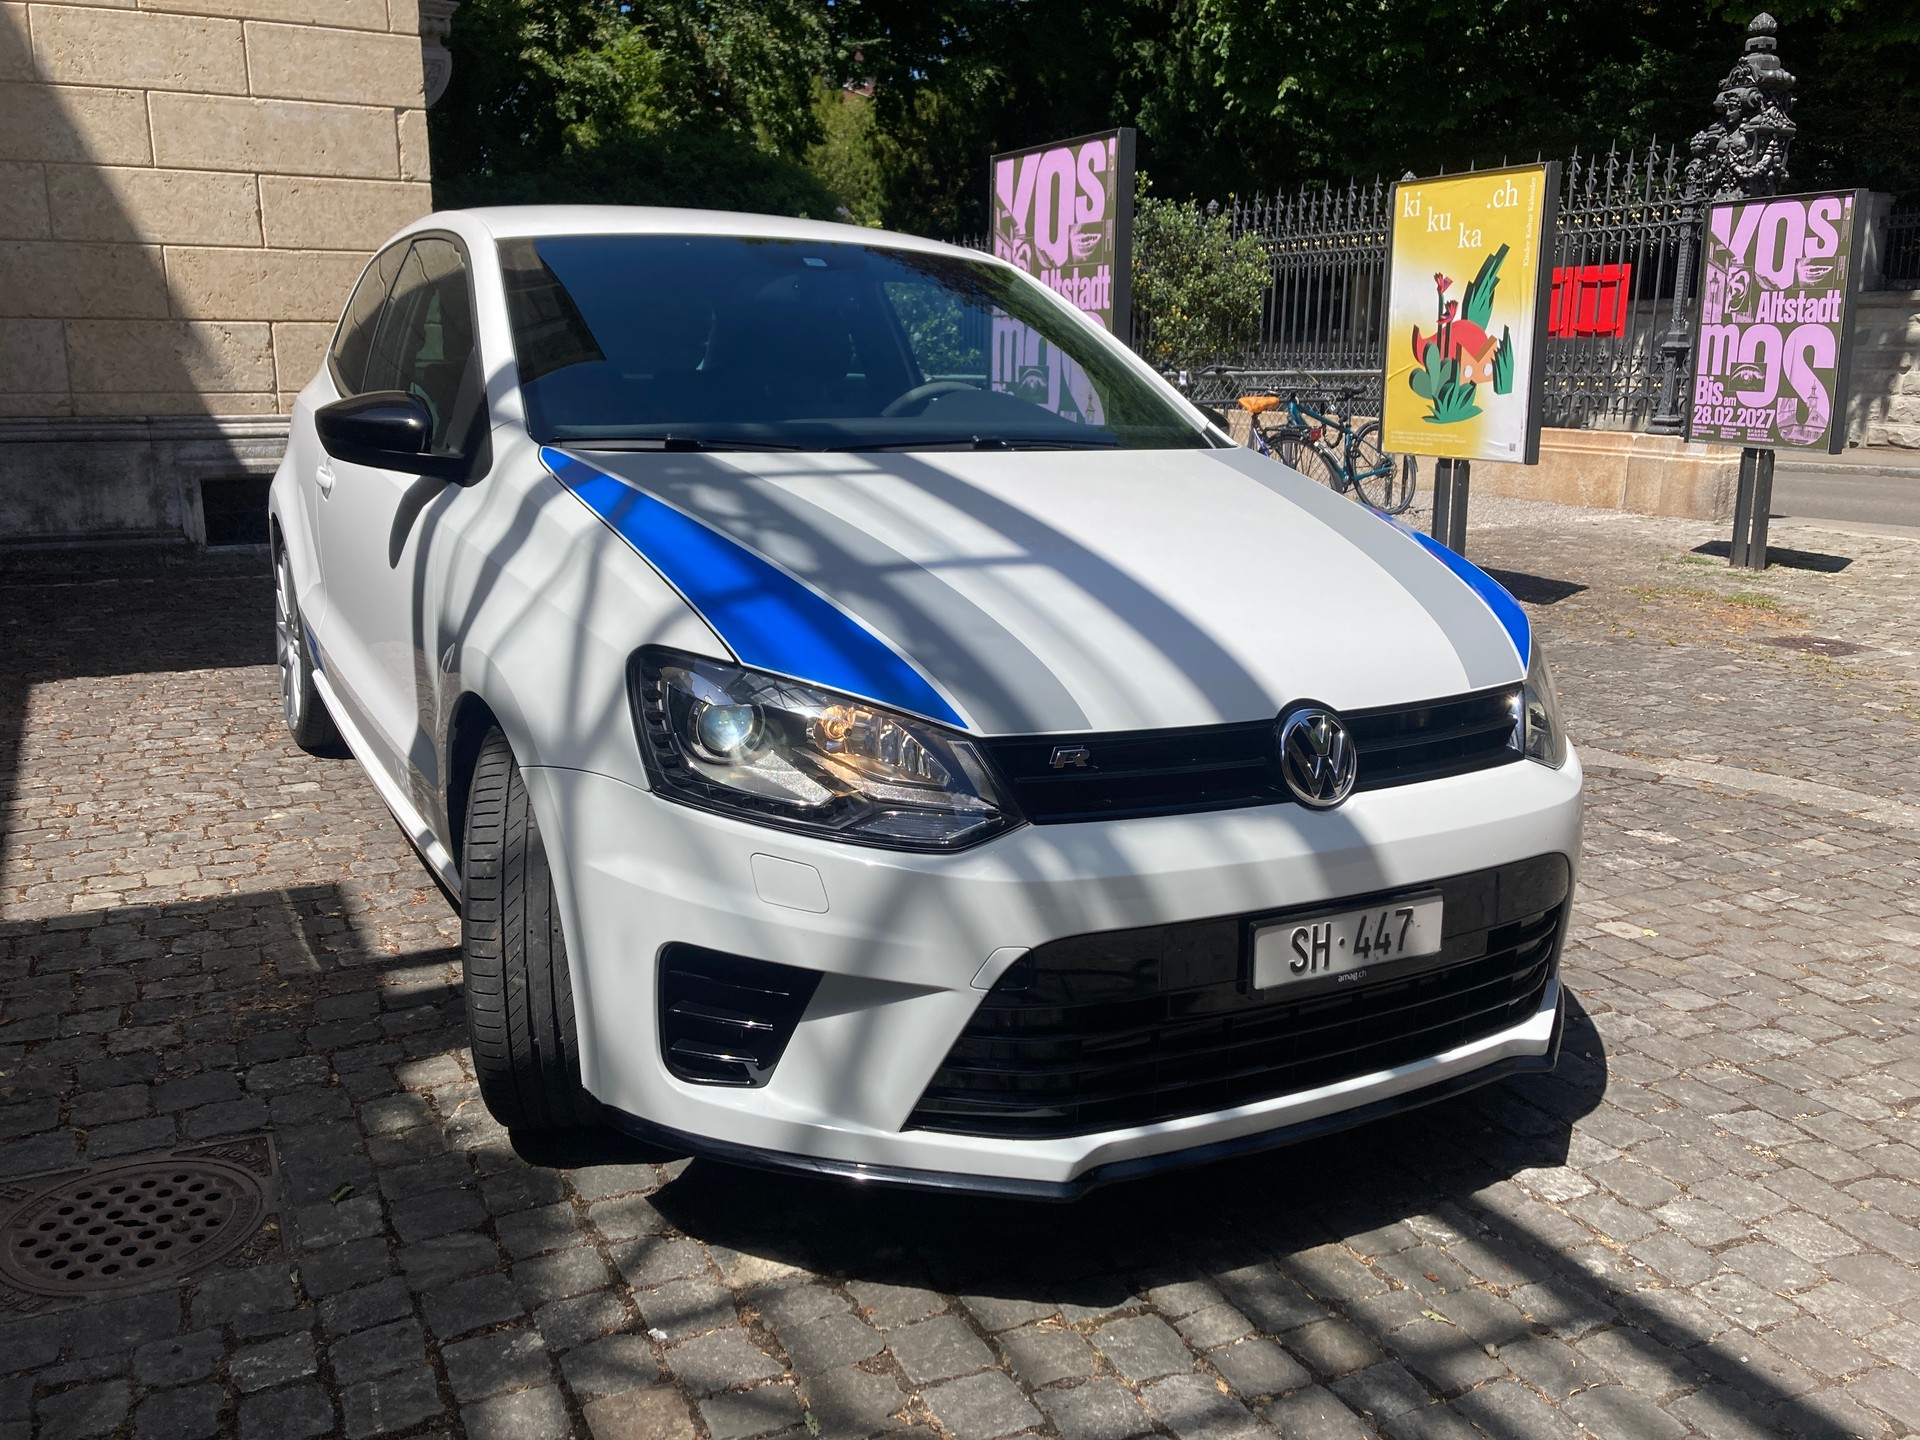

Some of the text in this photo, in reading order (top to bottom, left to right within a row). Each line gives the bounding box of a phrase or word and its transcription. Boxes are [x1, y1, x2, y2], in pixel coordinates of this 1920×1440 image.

[1403, 192, 1421, 218] ki
[1427, 206, 1451, 232] ku
[1457, 222, 1482, 249] ka
[1755, 289, 1842, 323] Altstadt
[1694, 375, 1737, 407] Bis am
[1692, 404, 1776, 429] 28.02.2027
